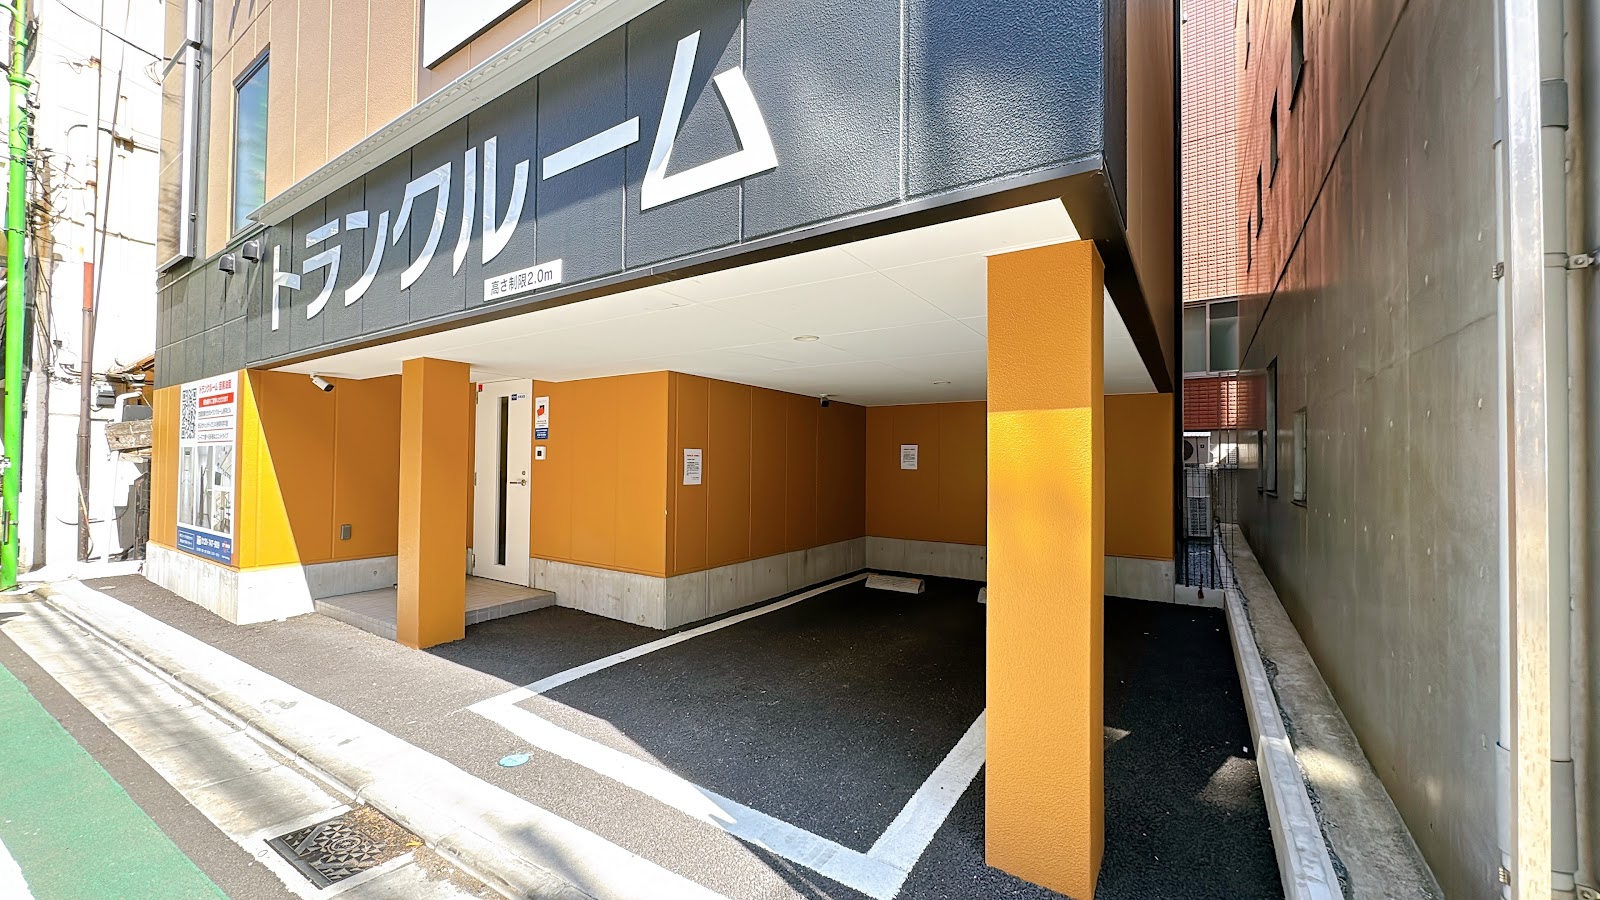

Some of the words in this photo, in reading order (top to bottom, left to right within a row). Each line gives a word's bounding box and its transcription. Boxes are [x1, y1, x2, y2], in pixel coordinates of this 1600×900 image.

[272, 30, 779, 332] トランクルーム
[490, 268, 553, 296] 高さ制限2.0m
